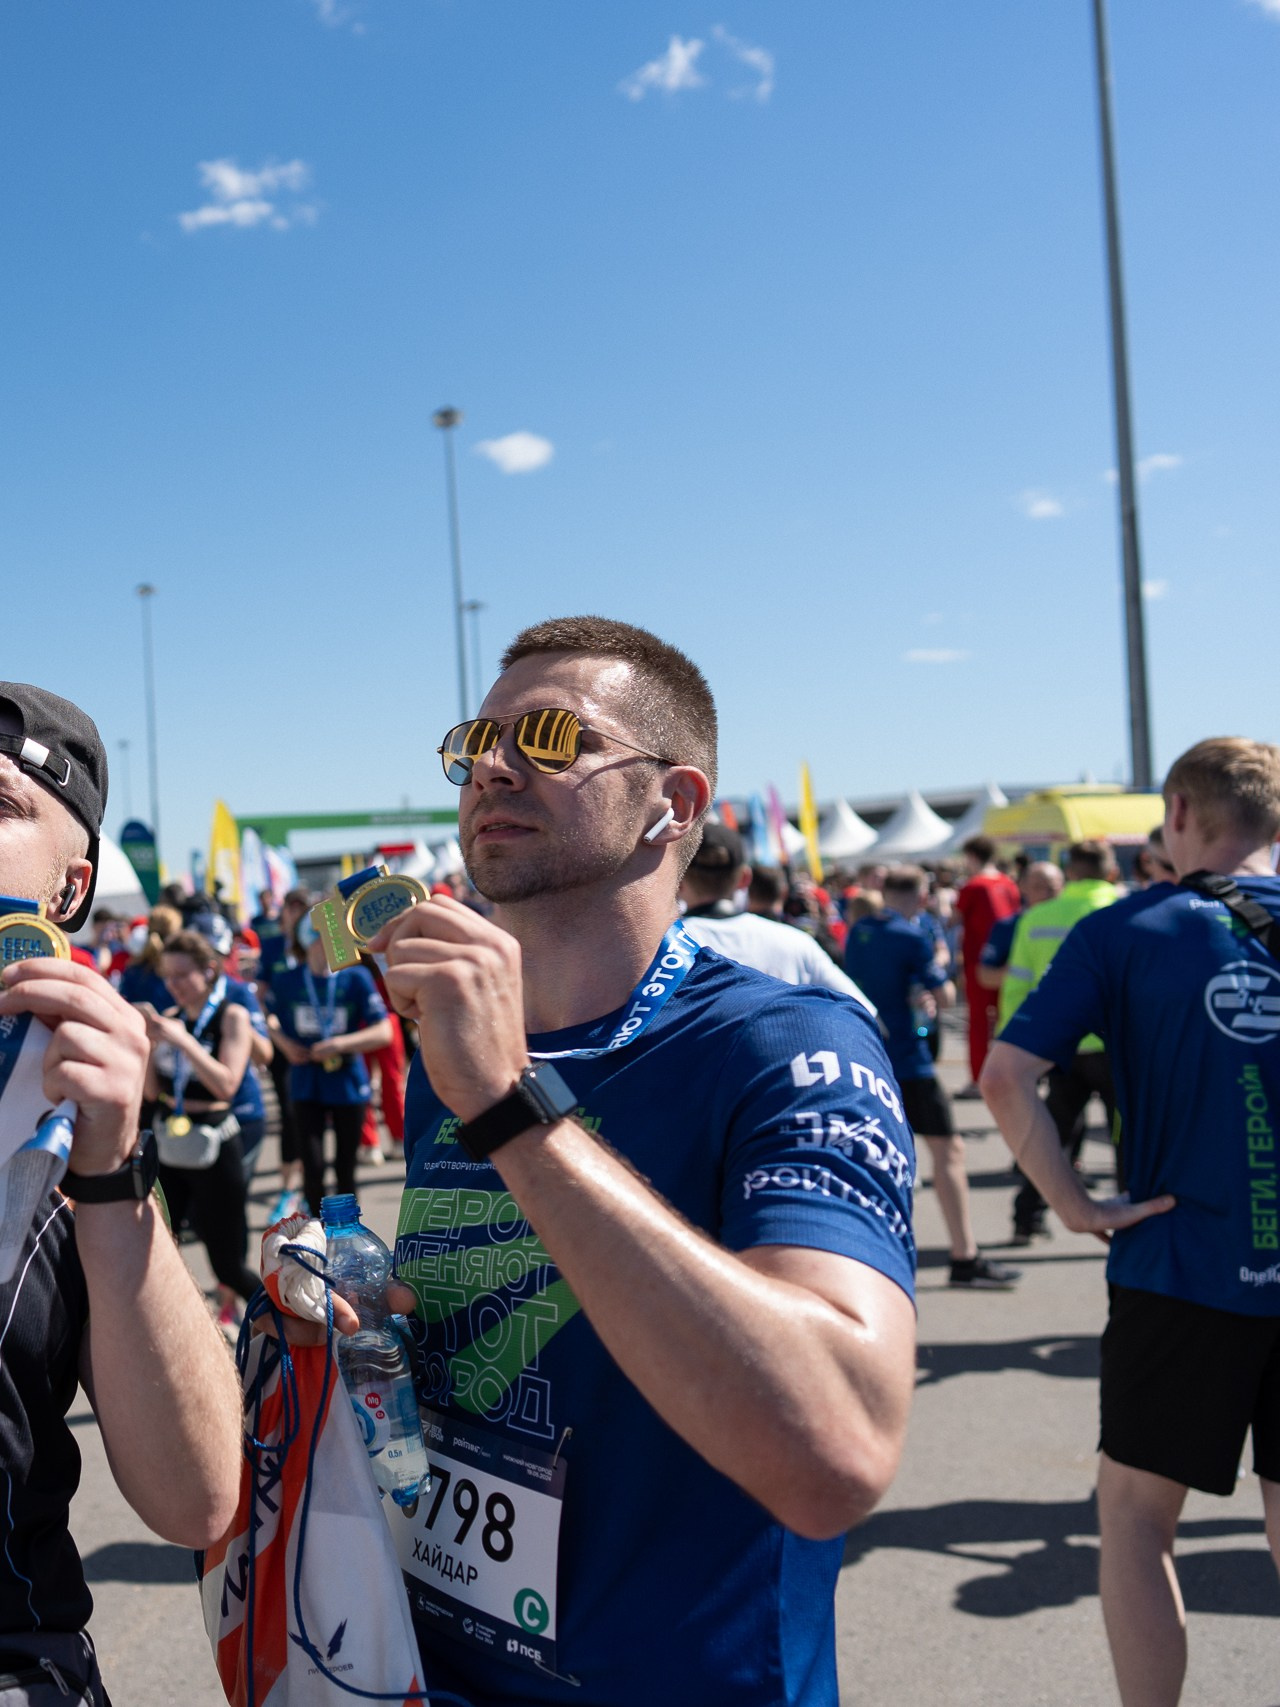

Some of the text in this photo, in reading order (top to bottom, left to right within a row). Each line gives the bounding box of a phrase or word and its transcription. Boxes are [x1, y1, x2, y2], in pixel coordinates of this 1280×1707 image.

[2, 937, 42, 950] БЕГИ
[642, 940, 691, 997] ЭТОТ
[395, 1239, 559, 1297] МЕНЯЮТ
[367, 1396, 379, 1406] Mg
[418, 1350, 555, 1440] ОРОД
[388, 1449, 403, 1459] 0,5л
[525, 1460, 553, 1475] НОВГОРОД
[412, 1537, 478, 1587] ХАЙДАР
[521, 1595, 543, 1629] C
[520, 1643, 543, 1662] ПСБ
